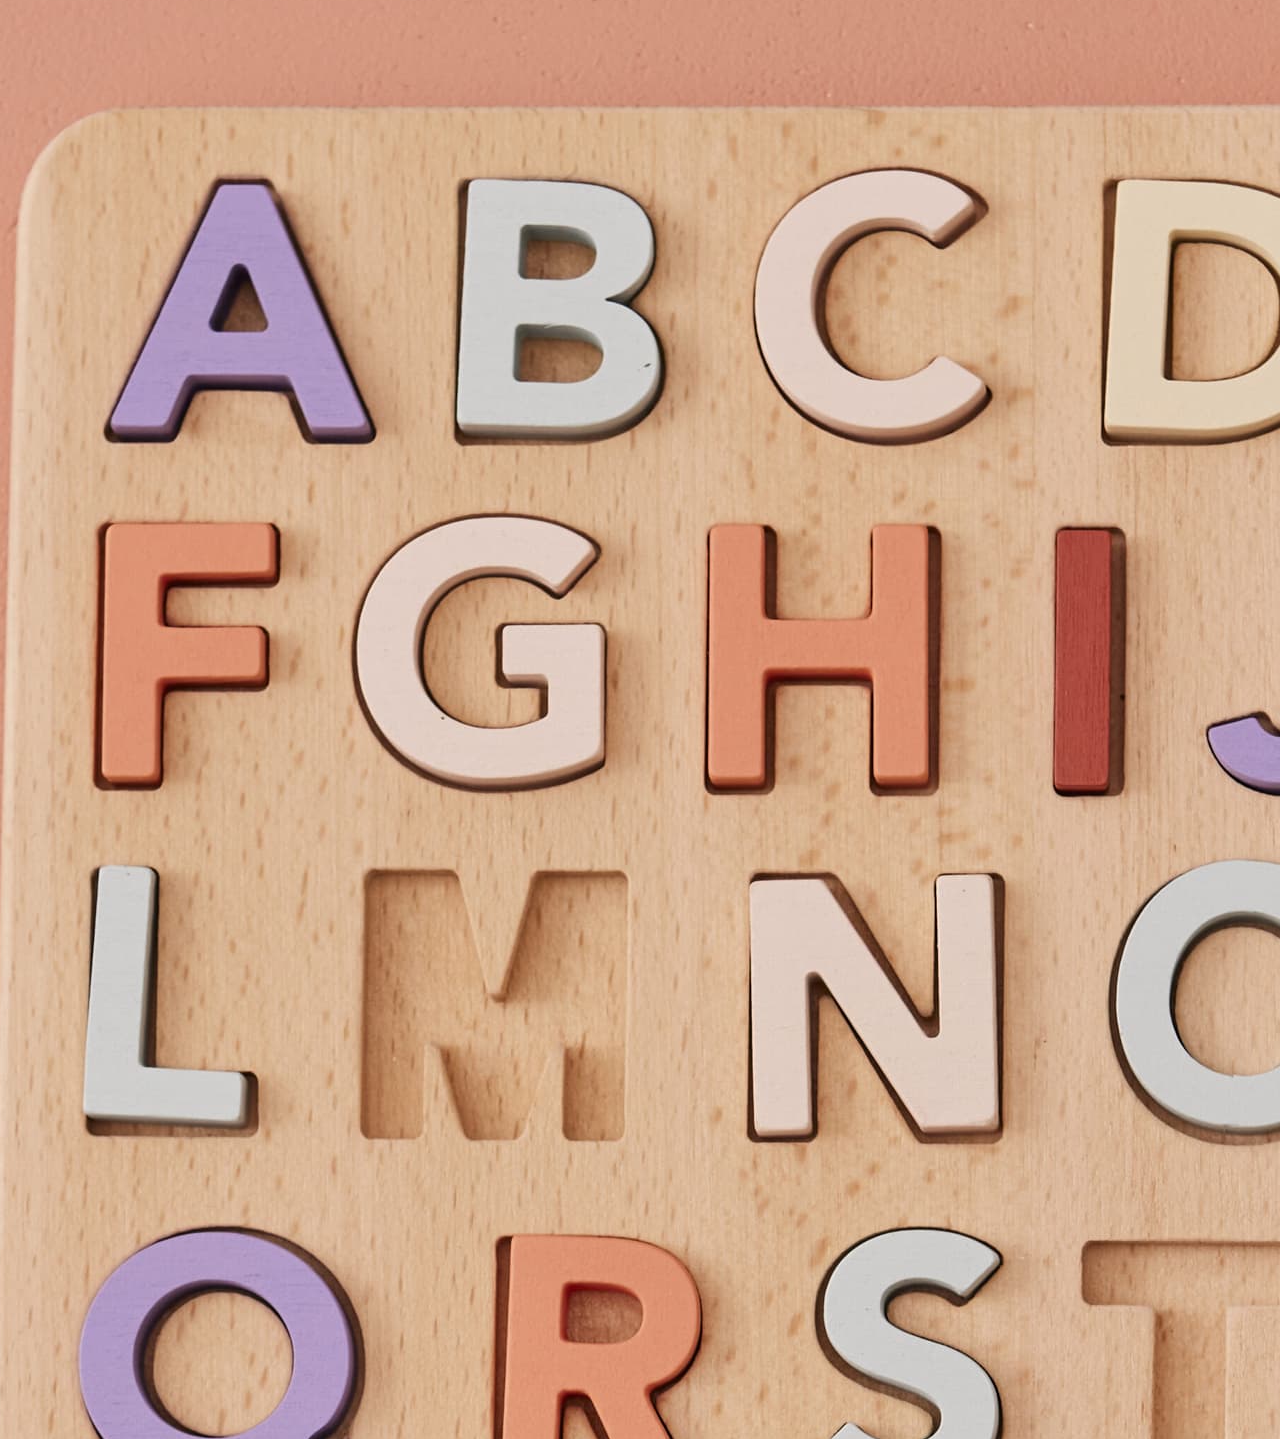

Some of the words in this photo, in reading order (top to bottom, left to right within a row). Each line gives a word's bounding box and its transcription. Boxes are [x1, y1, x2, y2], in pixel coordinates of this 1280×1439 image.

[107, 177, 375, 442] A
[455, 178, 665, 442] B
[754, 168, 991, 442] C
[96, 520, 280, 788] F
[354, 514, 607, 790] G
[706, 523, 938, 793] H
[1052, 527, 1123, 796] I
[84, 866, 256, 1133] L
[360, 869, 629, 1139] M
[746, 870, 1003, 1141] N
